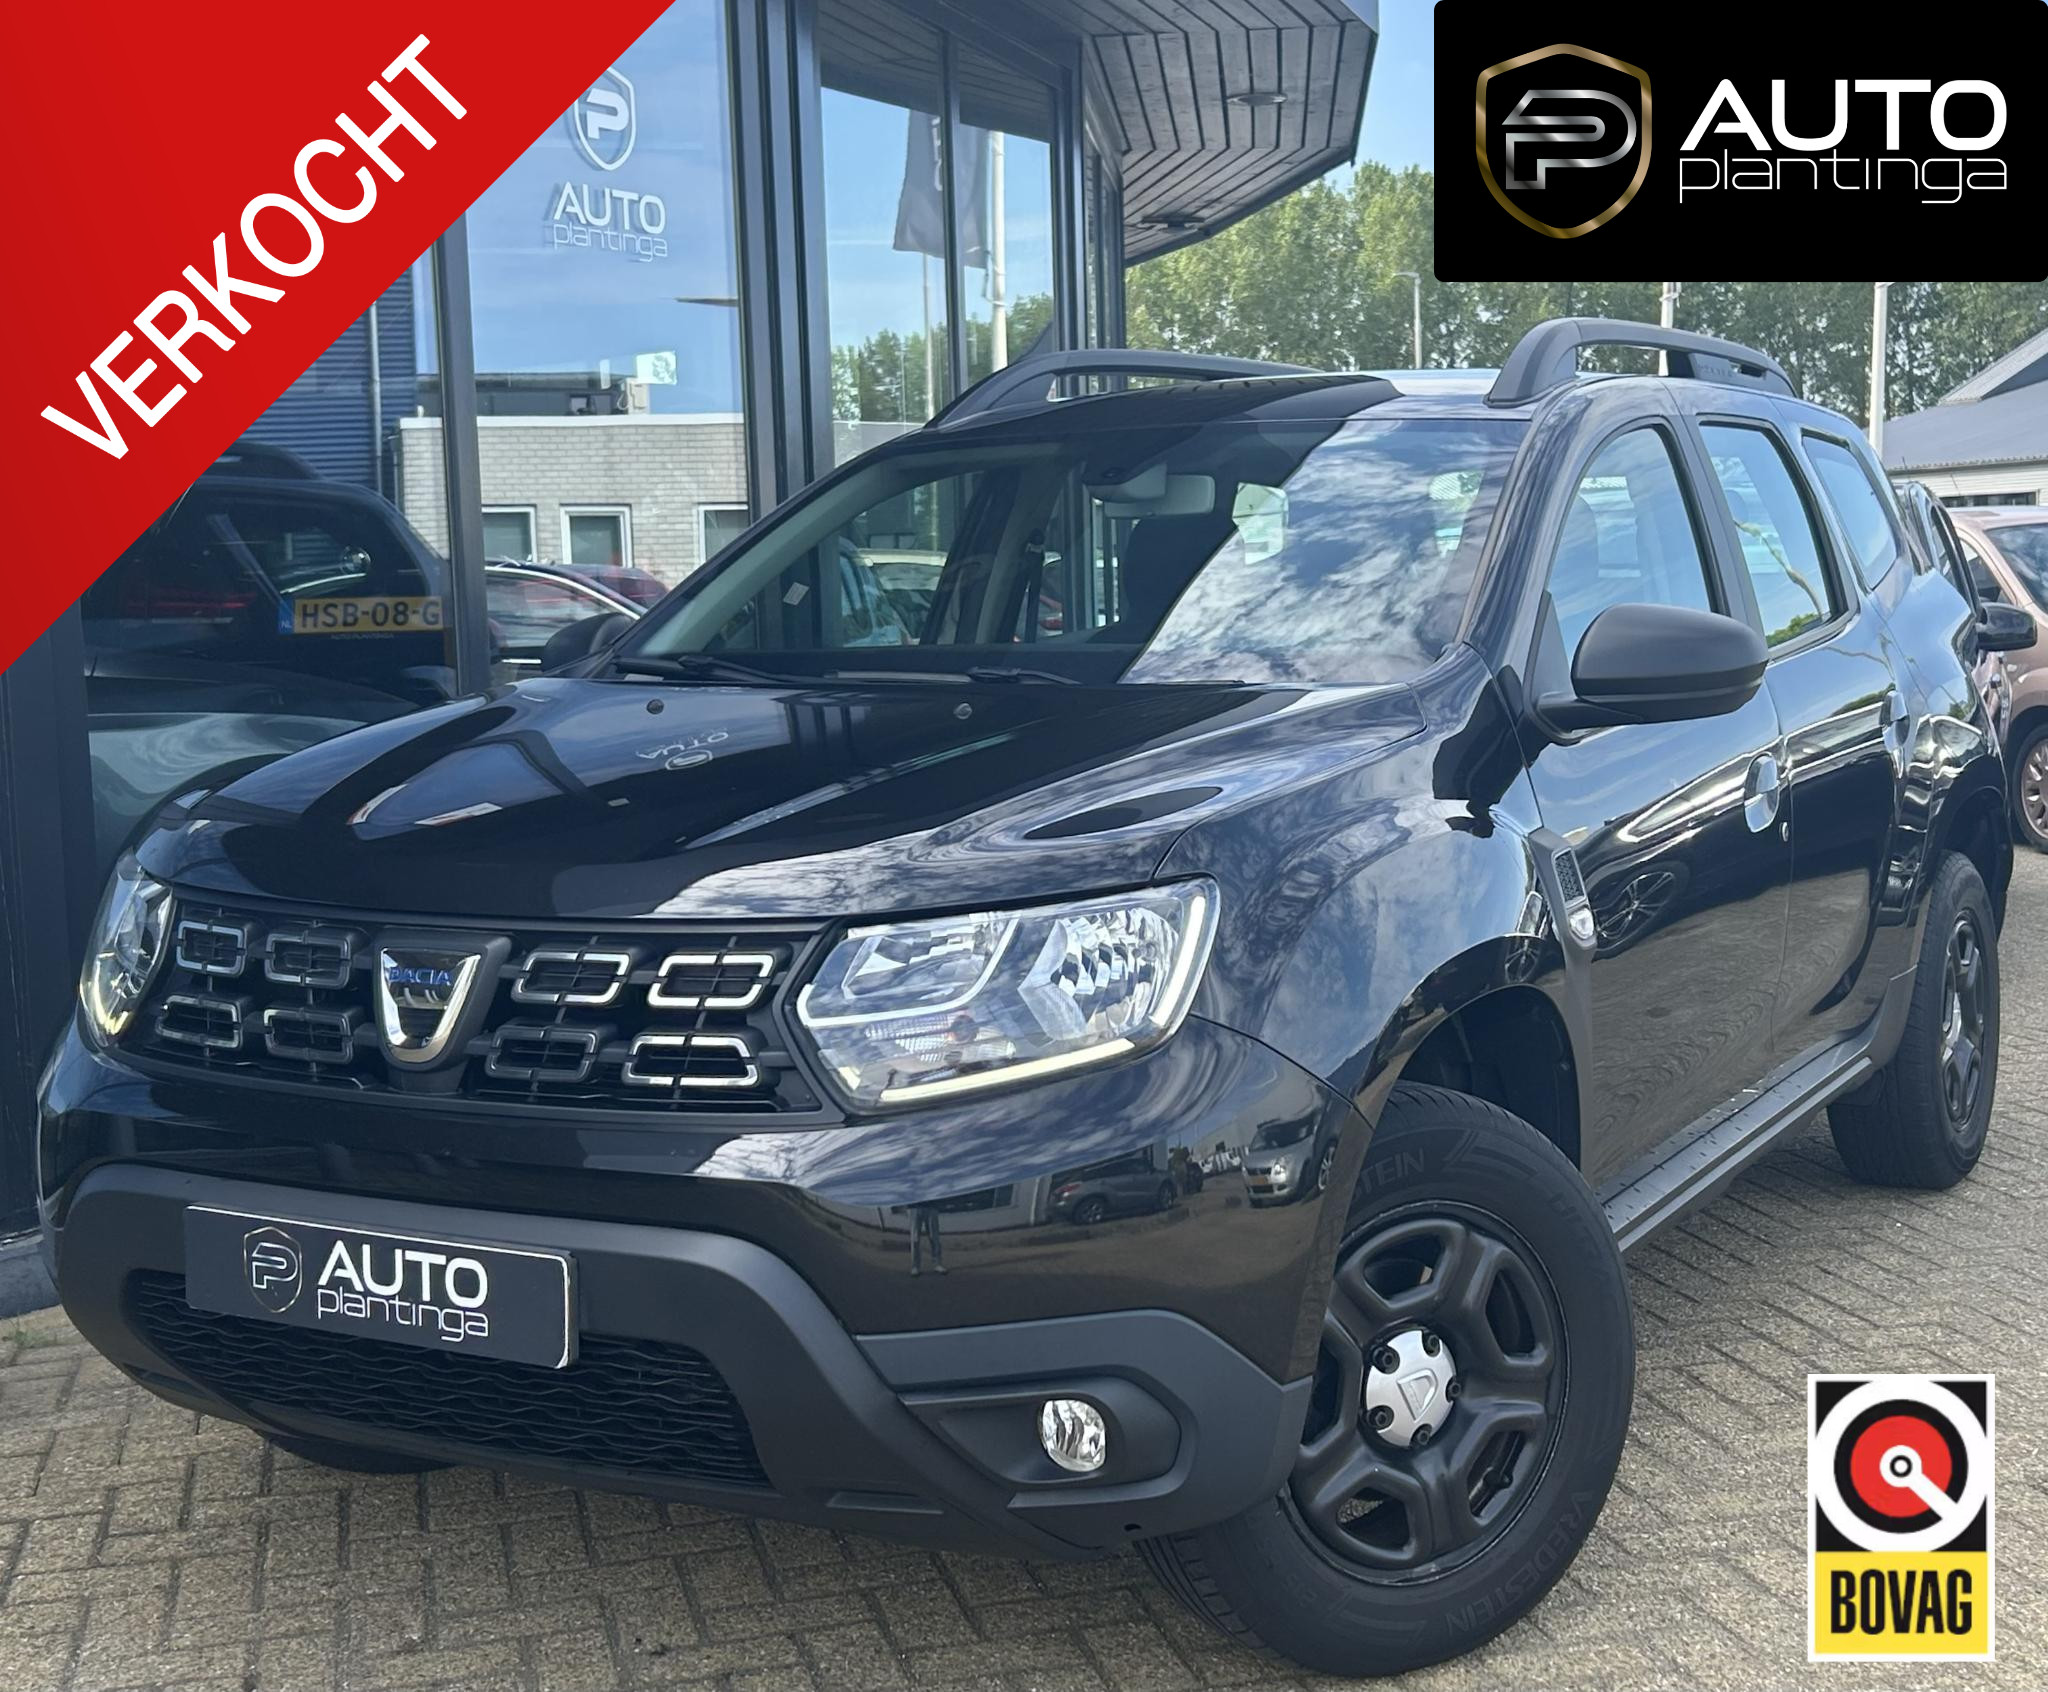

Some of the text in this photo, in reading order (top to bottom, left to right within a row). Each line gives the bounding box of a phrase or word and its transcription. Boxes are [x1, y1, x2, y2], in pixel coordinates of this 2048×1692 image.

[553, 181, 666, 234] AUTO
[553, 221, 668, 263] plantinga
[301, 601, 440, 628] HSB-08-G
[318, 1239, 488, 1309] AUTO
[317, 1286, 488, 1342] plantinga
